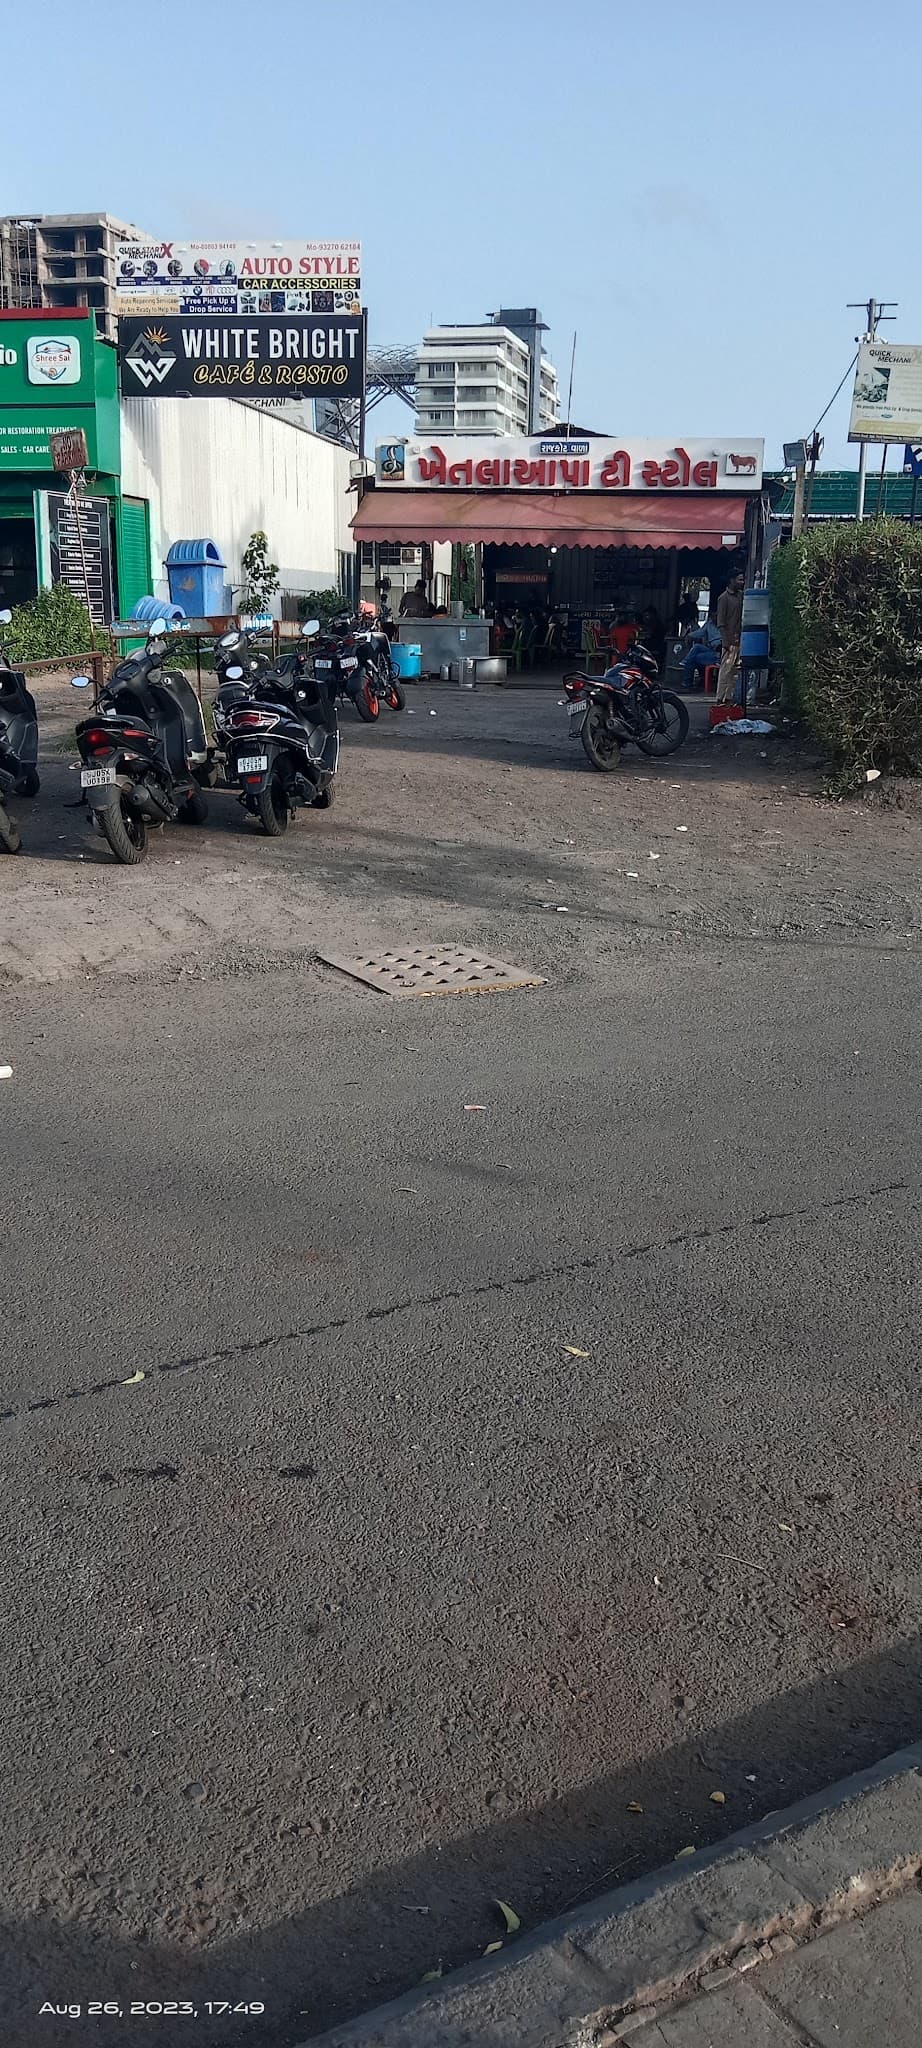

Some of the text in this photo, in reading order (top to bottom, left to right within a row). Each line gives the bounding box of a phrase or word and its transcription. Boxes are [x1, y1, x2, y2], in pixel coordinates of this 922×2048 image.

[240, 257, 360, 275] AUTO STYLE
[243, 278, 269, 289] CAR
[271, 278, 357, 289] ACCESSORIES
[186, 297, 202, 305] Free
[203, 296, 218, 305] Pick
[219, 297, 229, 306] Up
[189, 305, 233, 313] Drop Service
[182, 328, 360, 359] WHITE BRIGHT
[35, 354, 70, 362] Shree Sai
[193, 360, 349, 386] CAFÉ & RESTO
[249, 398, 286, 408] CHANI
[8, 426, 45, 435] RESTORATION
[1, 446, 18, 454] SALES
[22, 446, 35, 454] CAR
[541, 442, 588, 454] રાજકોટ વાળા
[418, 445, 718, 487] ખેતલાઆપા ટી સ્ટોલ
